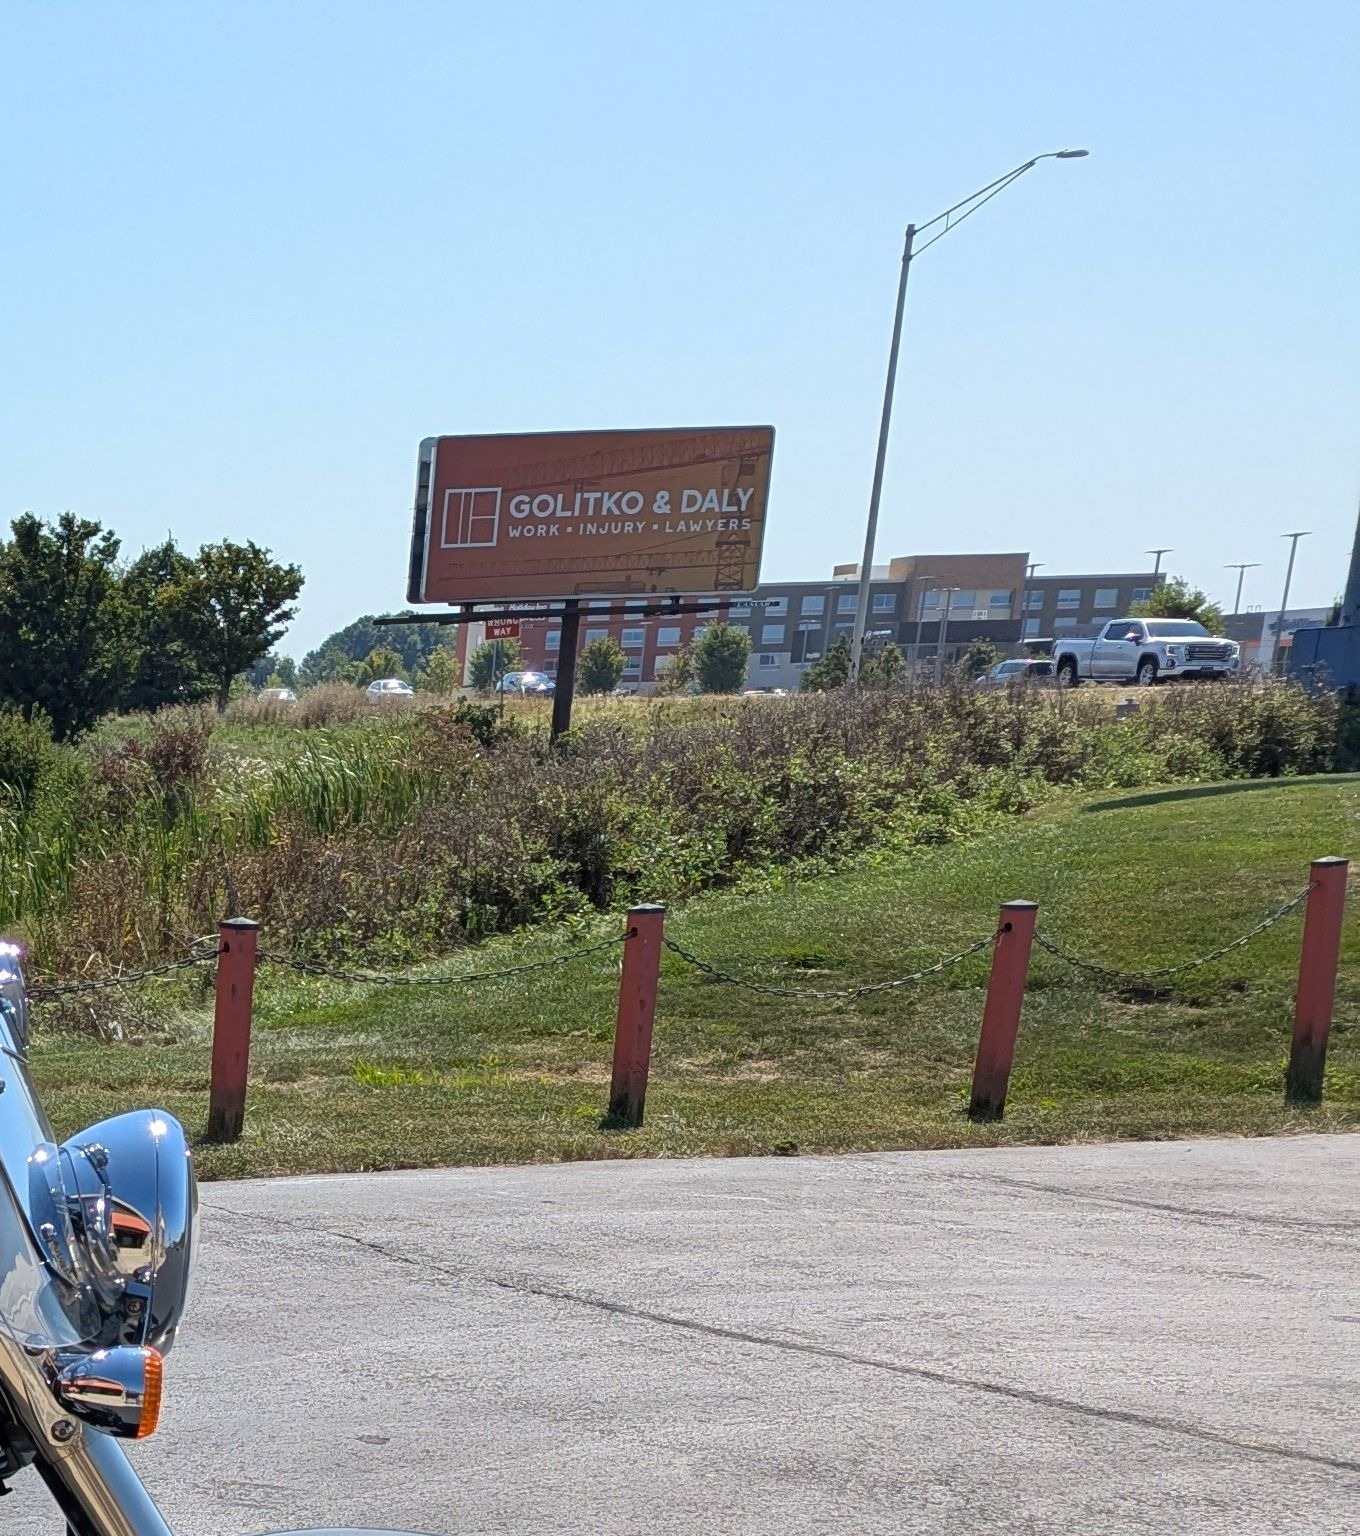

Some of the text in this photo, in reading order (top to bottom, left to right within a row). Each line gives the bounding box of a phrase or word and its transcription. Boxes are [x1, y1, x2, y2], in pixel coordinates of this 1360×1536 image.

[509, 487, 755, 518] GOLITKO & DALY
[508, 518, 753, 538] WORK INJURY LAWYERS
[493, 627, 512, 636] WAY
